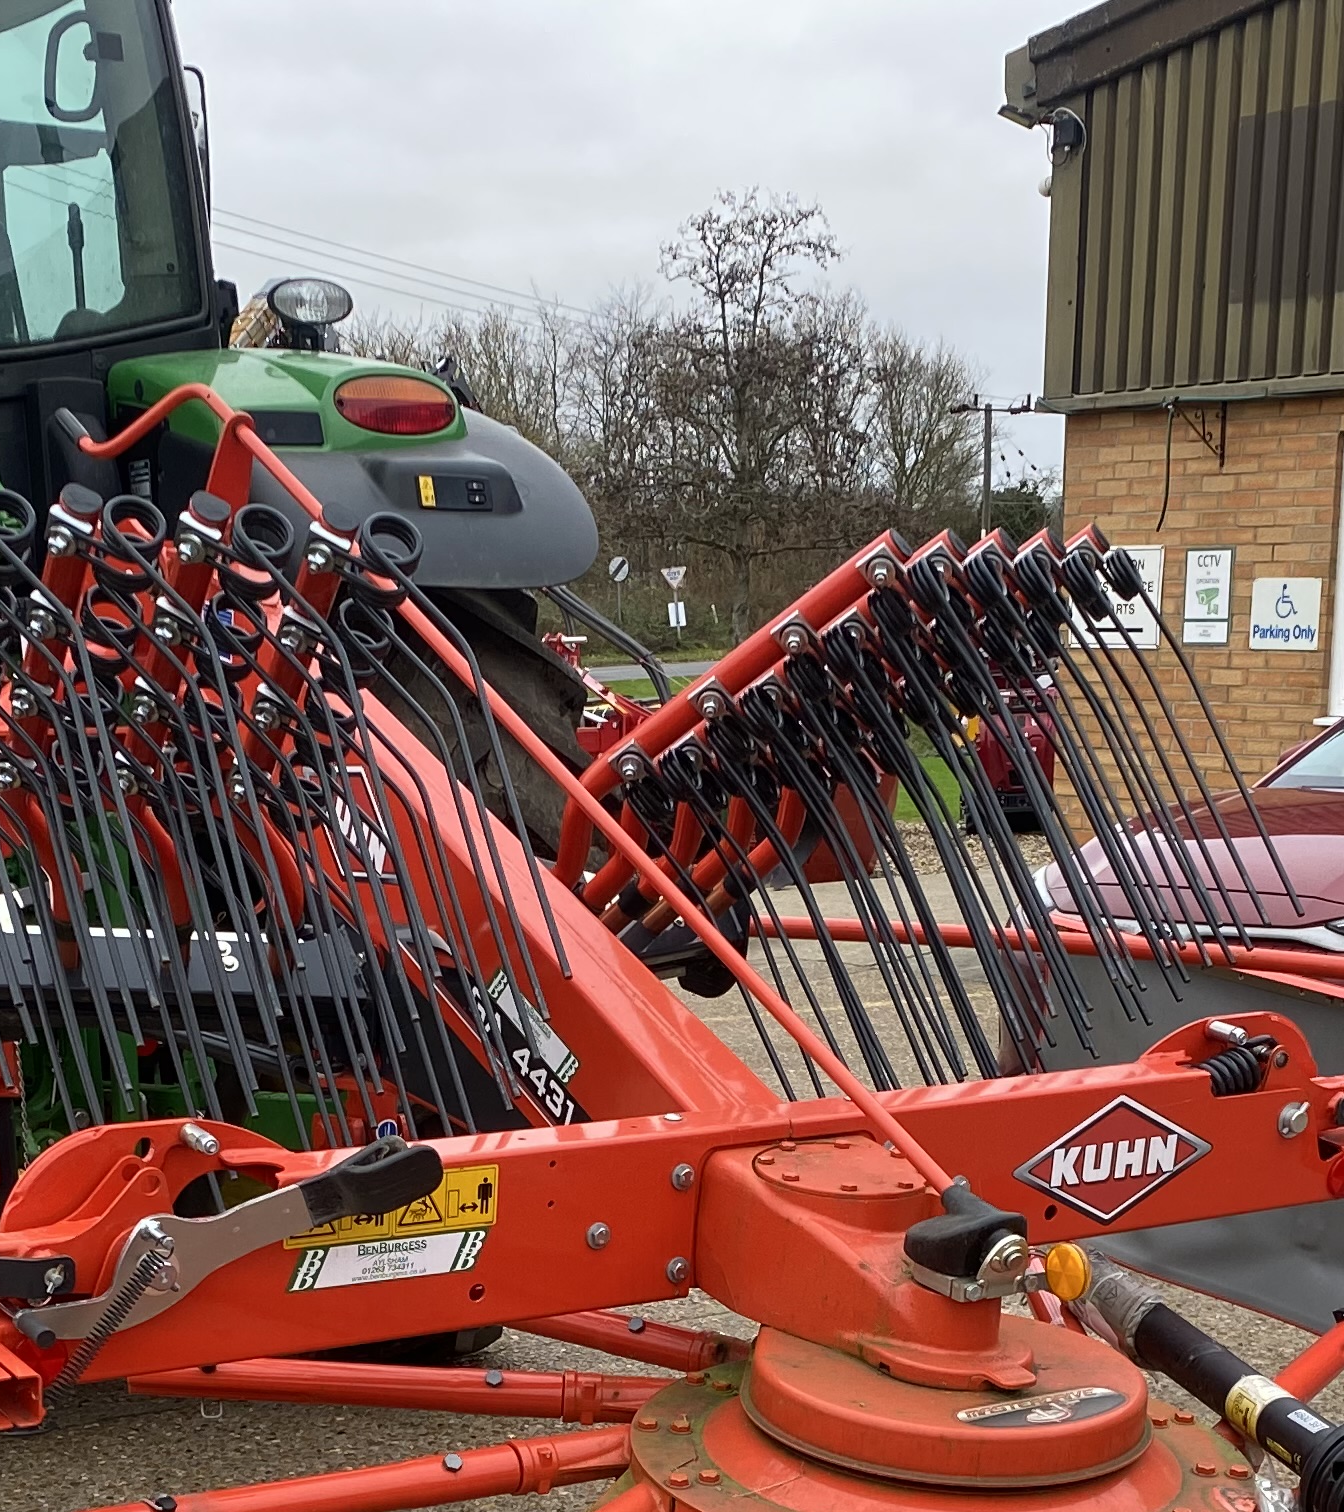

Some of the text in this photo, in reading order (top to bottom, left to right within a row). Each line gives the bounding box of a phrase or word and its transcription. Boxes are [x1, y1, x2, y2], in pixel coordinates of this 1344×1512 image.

[1197, 554, 1221, 568] CCTV
[1252, 624, 1316, 643] Parking Only
[512, 1048, 575, 1127] 4431
[1050, 1133, 1178, 1188] KUHN
